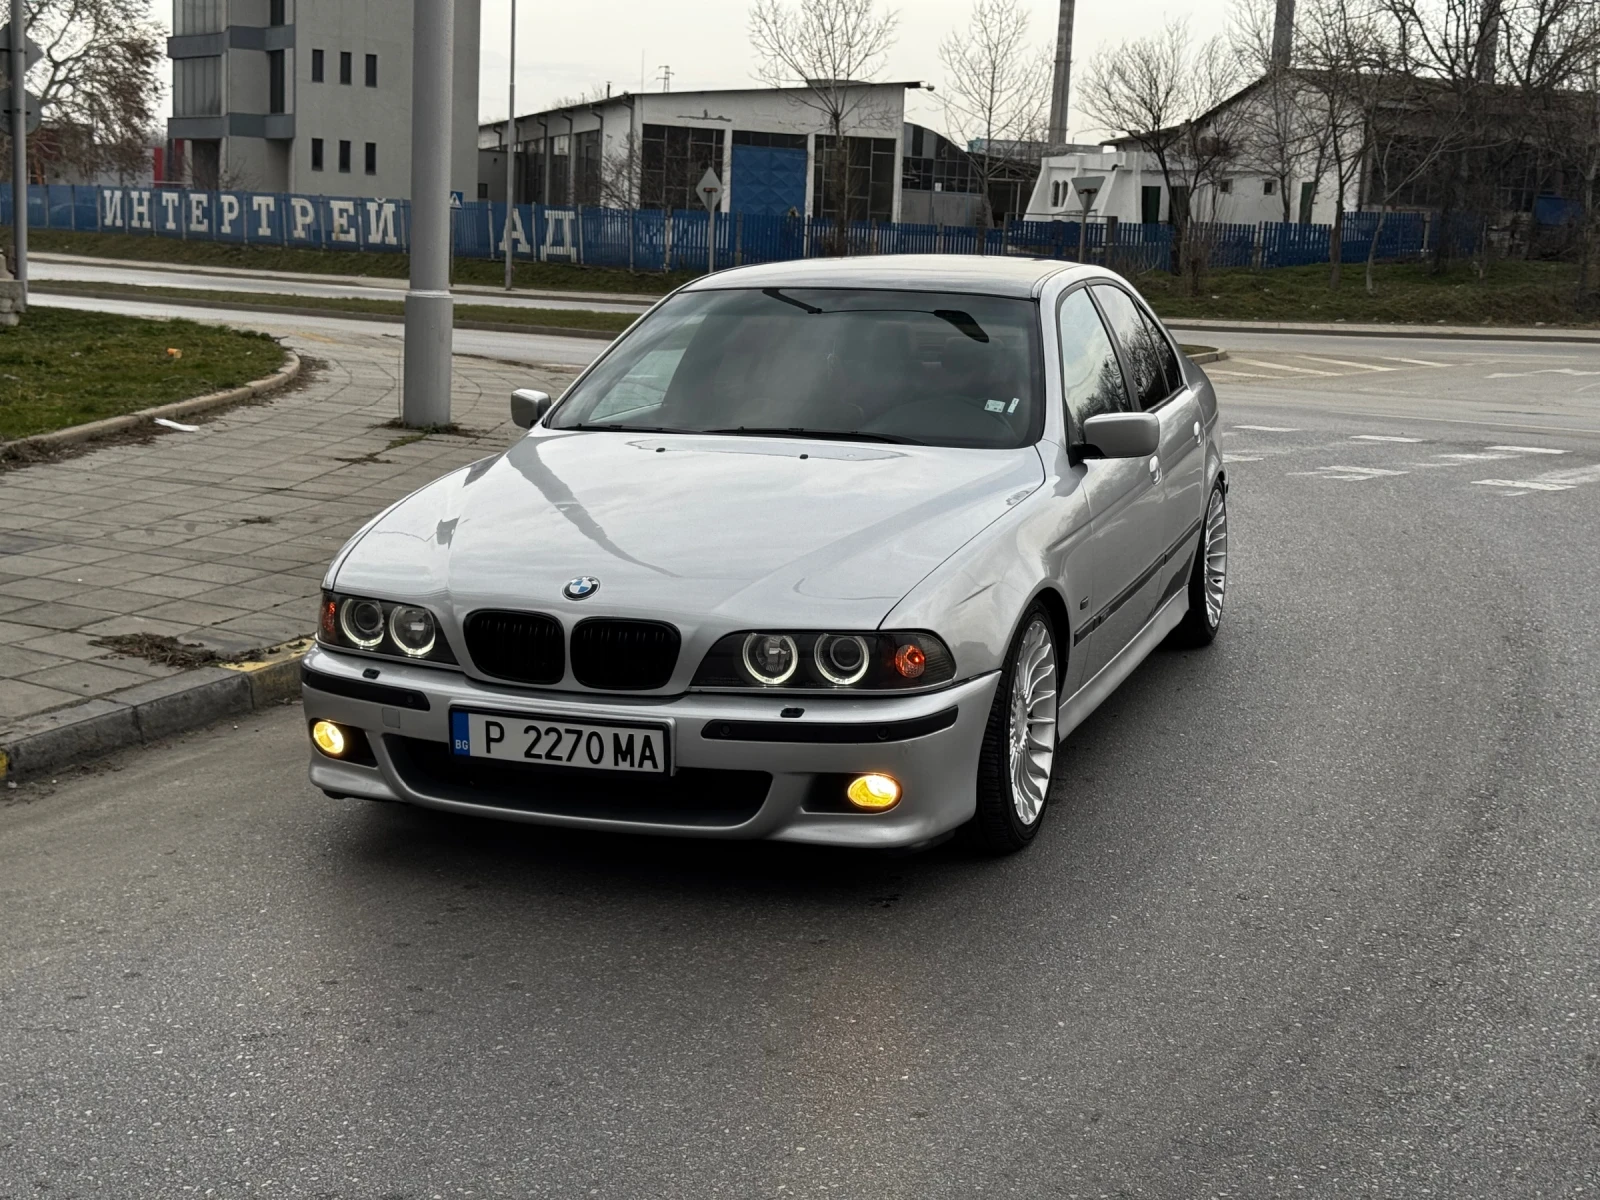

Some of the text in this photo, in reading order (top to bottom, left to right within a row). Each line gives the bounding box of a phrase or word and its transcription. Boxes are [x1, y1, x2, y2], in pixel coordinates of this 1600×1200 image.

[103, 189, 577, 263] ИНТЕРТРЕЙ АД
[455, 739, 469, 750] BG
[485, 720, 659, 769] P 2270 MA
